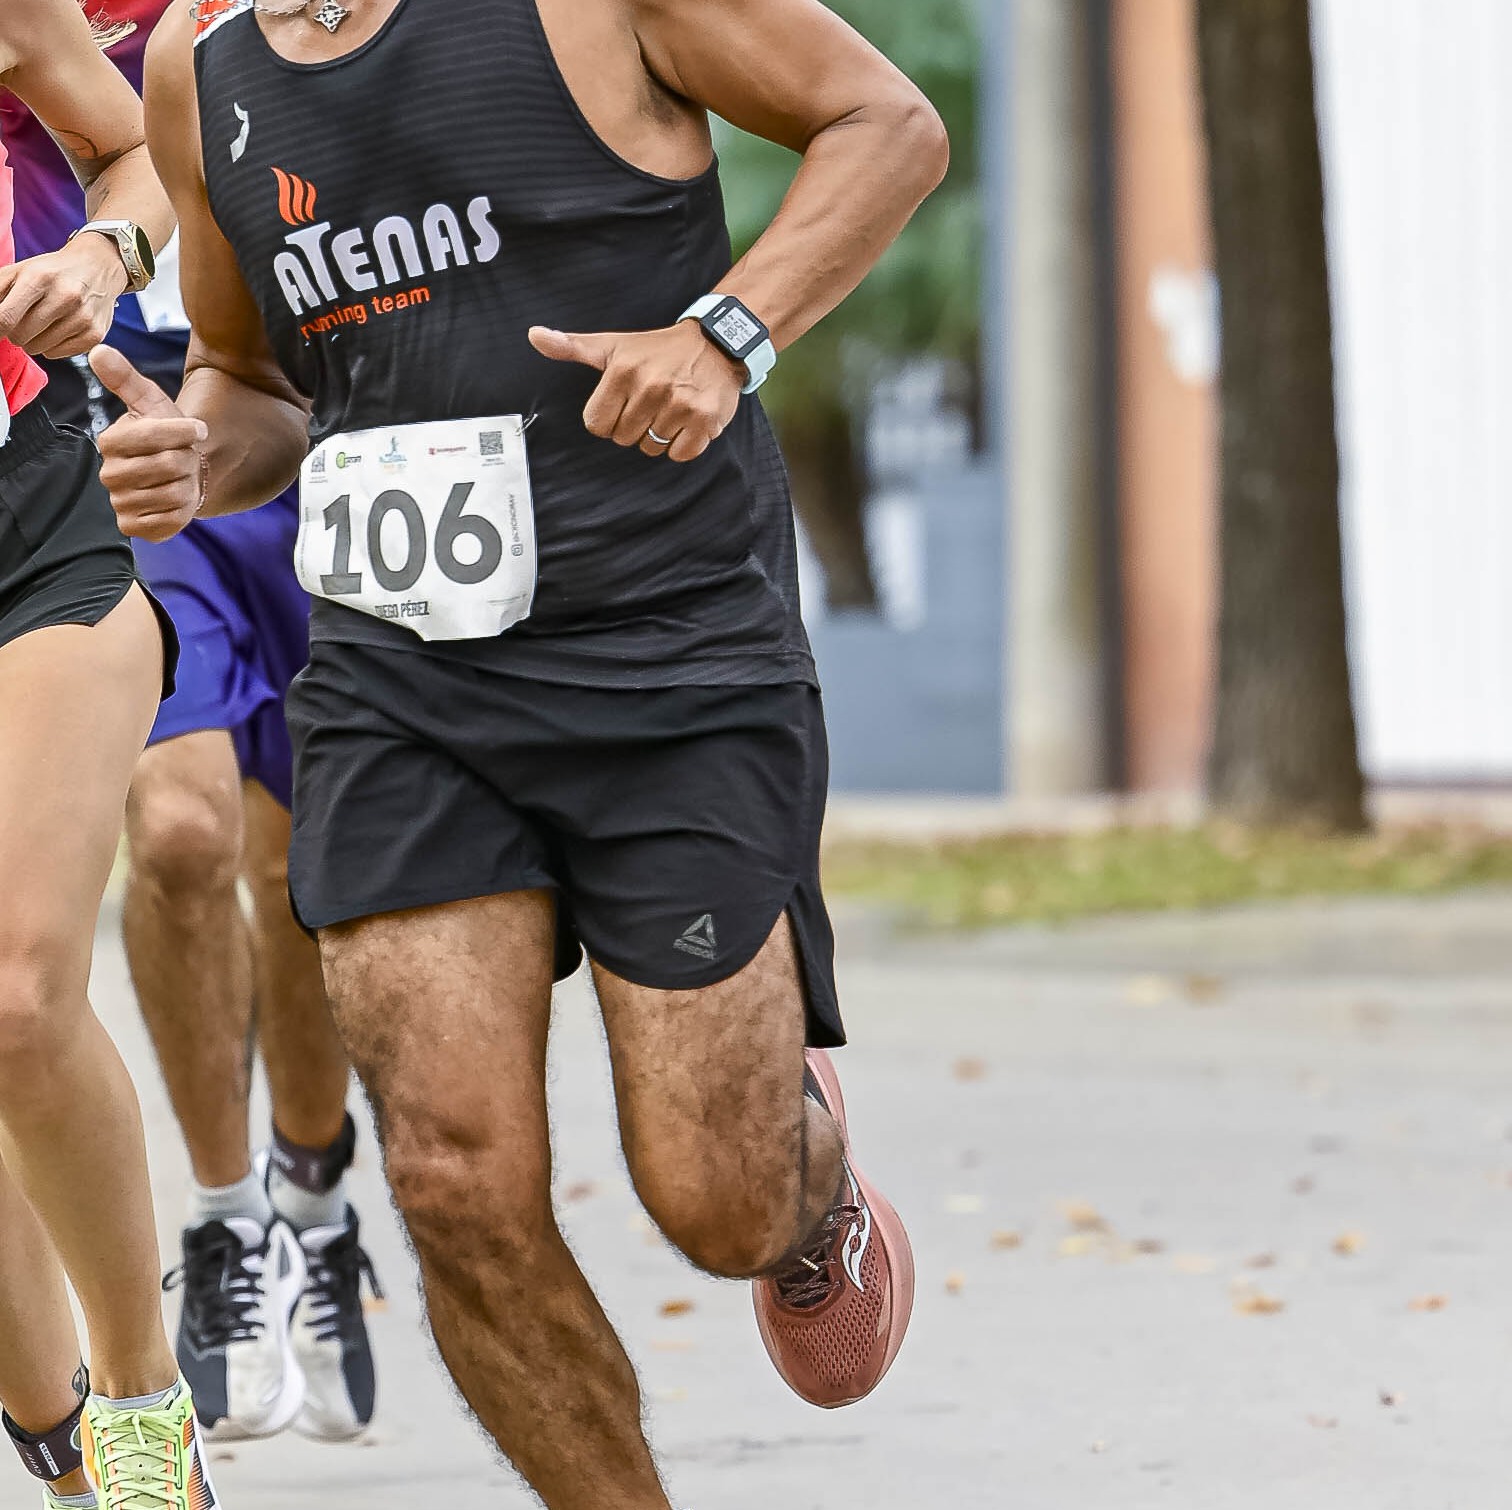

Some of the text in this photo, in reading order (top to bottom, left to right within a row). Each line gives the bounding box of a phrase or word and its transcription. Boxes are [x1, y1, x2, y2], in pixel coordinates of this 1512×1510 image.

[273, 195, 500, 316] ATENAS
[372, 287, 431, 315] team
[319, 481, 503, 595] 106
